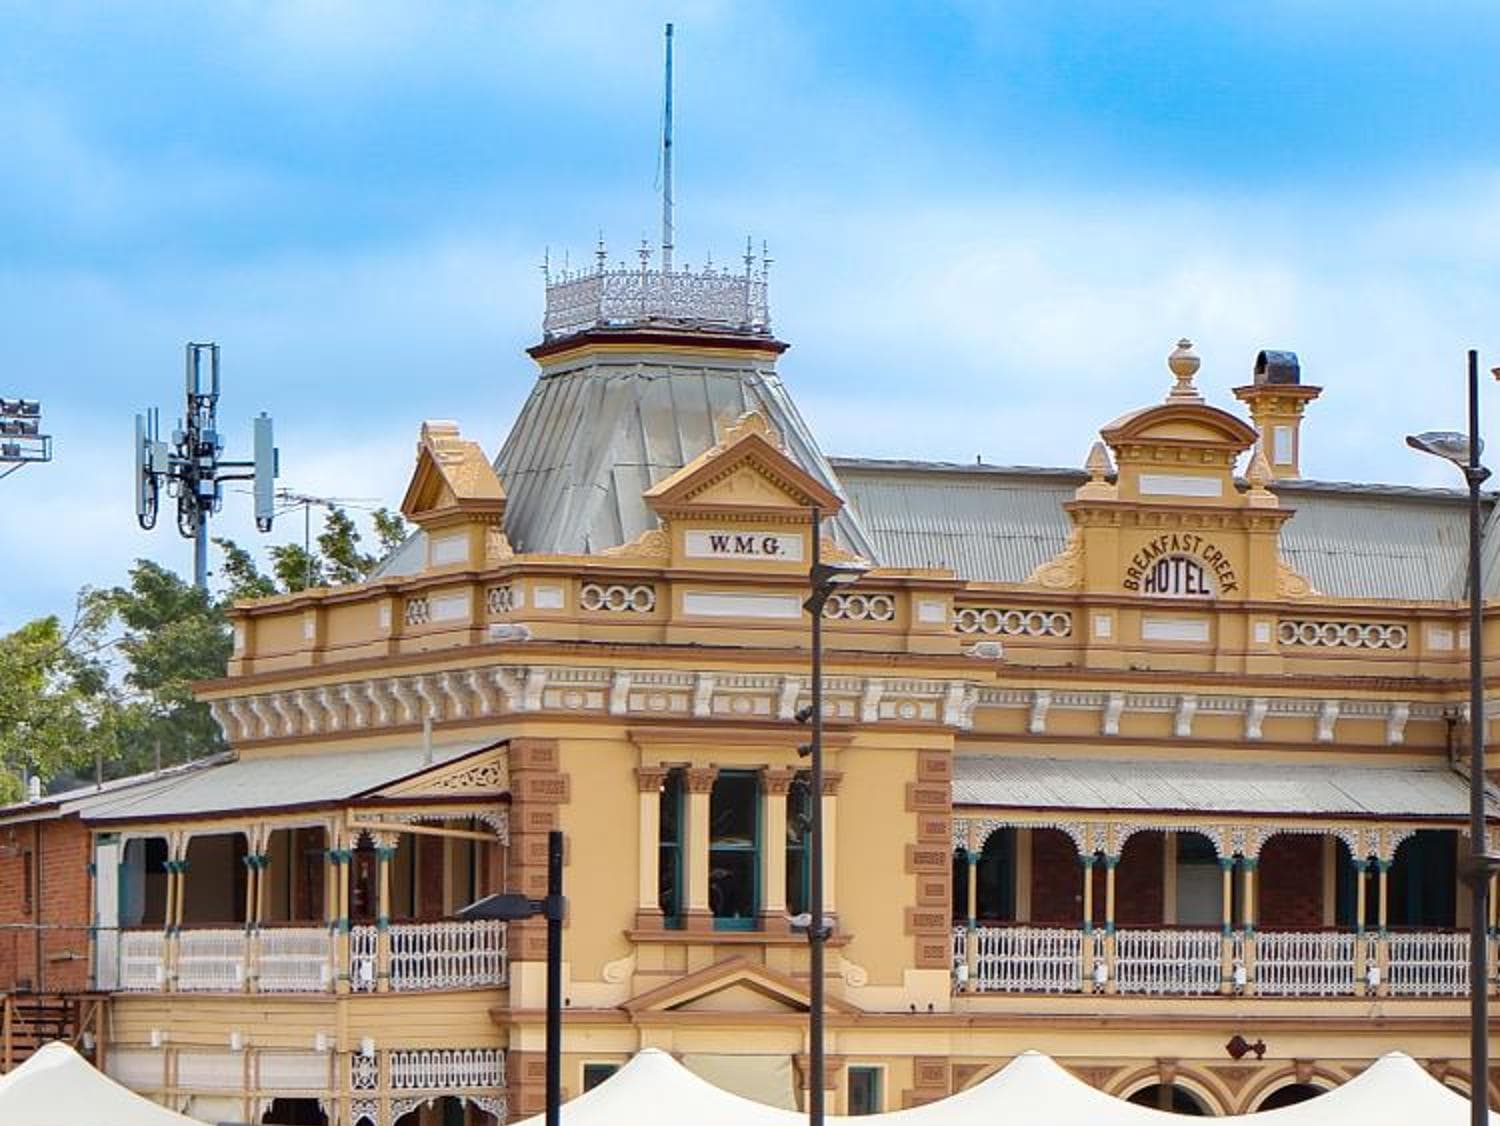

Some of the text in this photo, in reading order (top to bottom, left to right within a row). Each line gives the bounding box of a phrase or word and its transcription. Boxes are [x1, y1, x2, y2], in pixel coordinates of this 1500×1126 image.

[709, 535, 785, 556] W.M.G.
[1123, 533, 1239, 594] BREAKFAST CREEK
[1144, 556, 1210, 595] HOTEL
